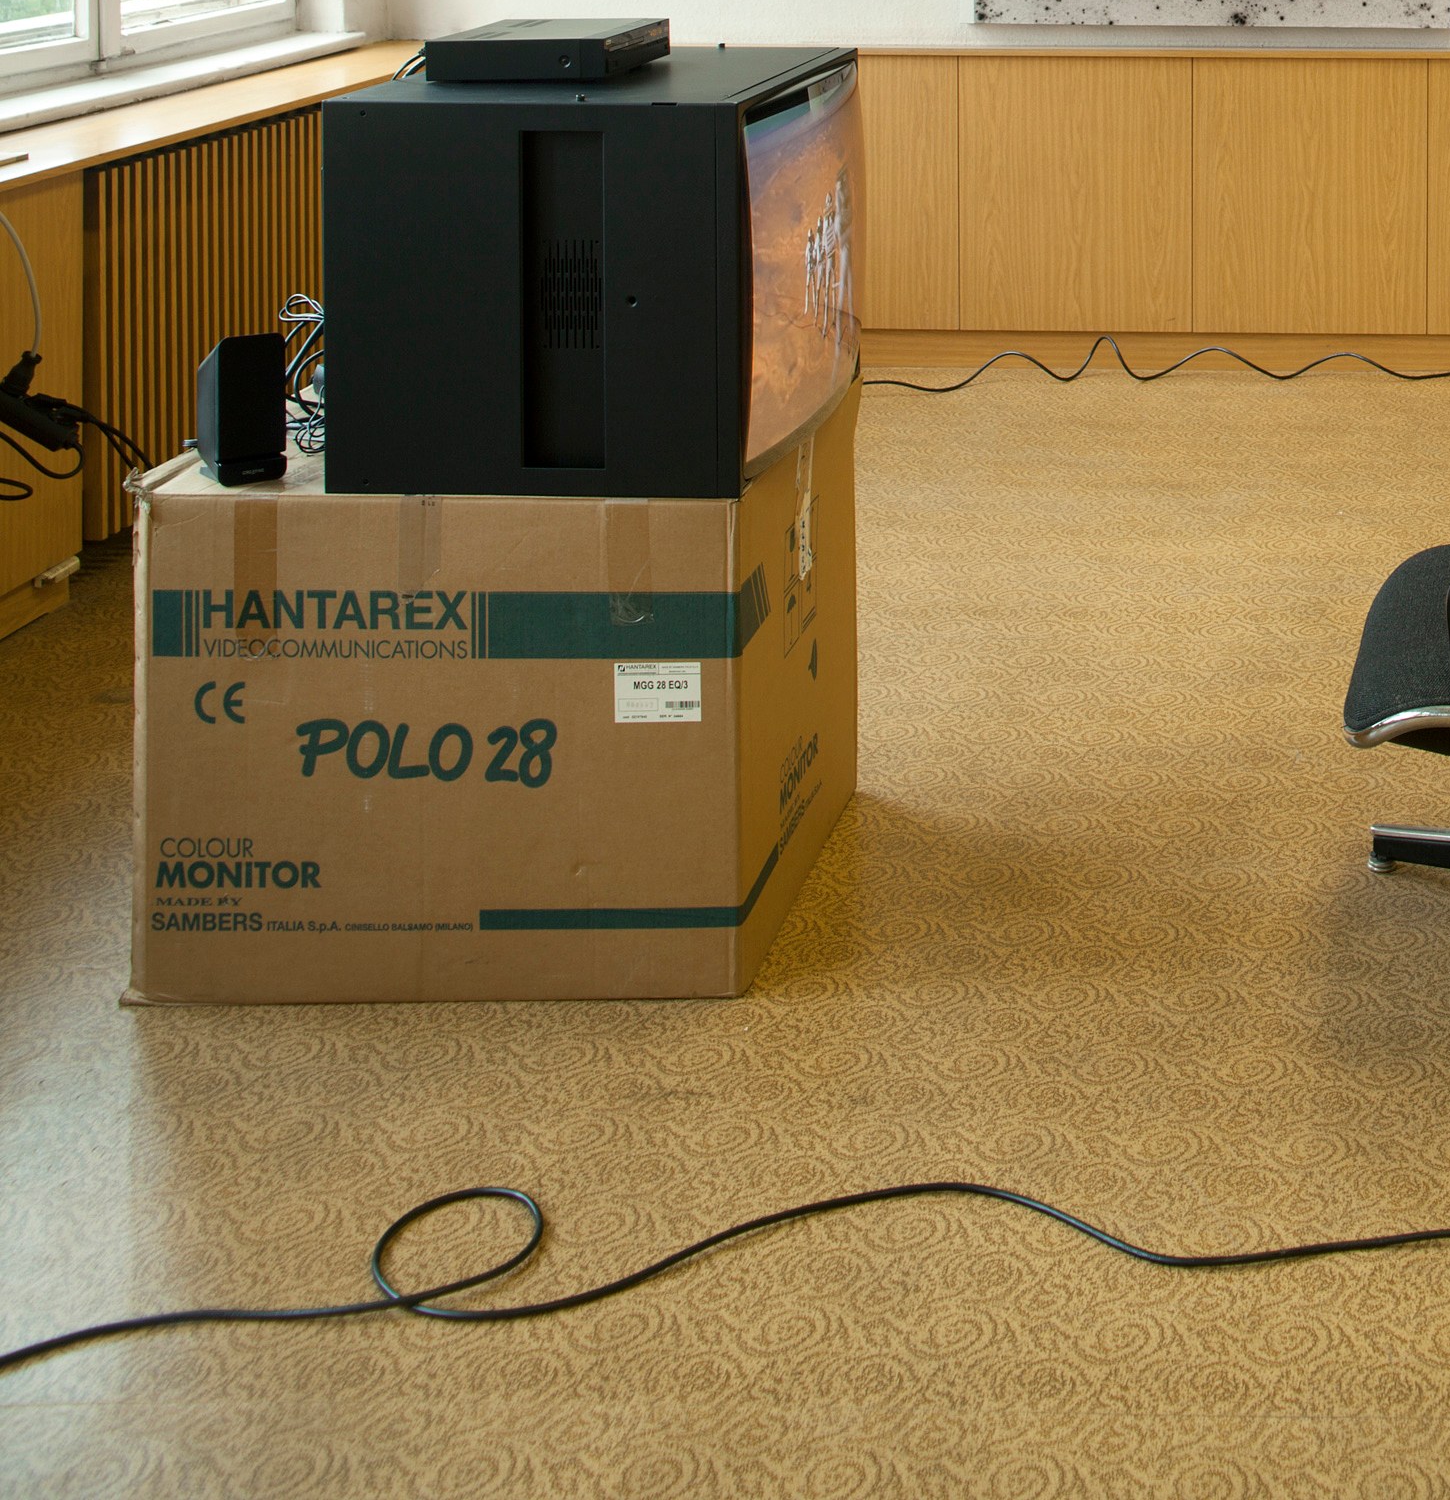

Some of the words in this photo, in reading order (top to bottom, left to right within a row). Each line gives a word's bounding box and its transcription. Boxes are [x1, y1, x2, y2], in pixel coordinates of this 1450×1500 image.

[202, 589, 468, 630] HANTAREX
[203, 639, 468, 659] VIDEOCOMMUNICATIONS
[633, 681, 654, 690] MGG
[656, 680, 667, 690] 28
[668, 680, 689, 690] EQ/3
[194, 681, 246, 725] CE
[296, 717, 475, 782] POLO
[484, 718, 558, 789] 28
[779, 732, 818, 814] MONITOR
[159, 837, 254, 859] COLOUR
[154, 860, 322, 889] MONITOR
[155, 896, 213, 906] MADE
[216, 895, 243, 906] BY
[151, 911, 263, 932] SAMBERS
[266, 921, 304, 932] ITALIA
[307, 920, 342, 933] S.p.A.
[344, 922, 390, 931] CINISELLO
[391, 922, 434, 931] BALSAMO
[434, 922, 474, 932] (MILANO)
